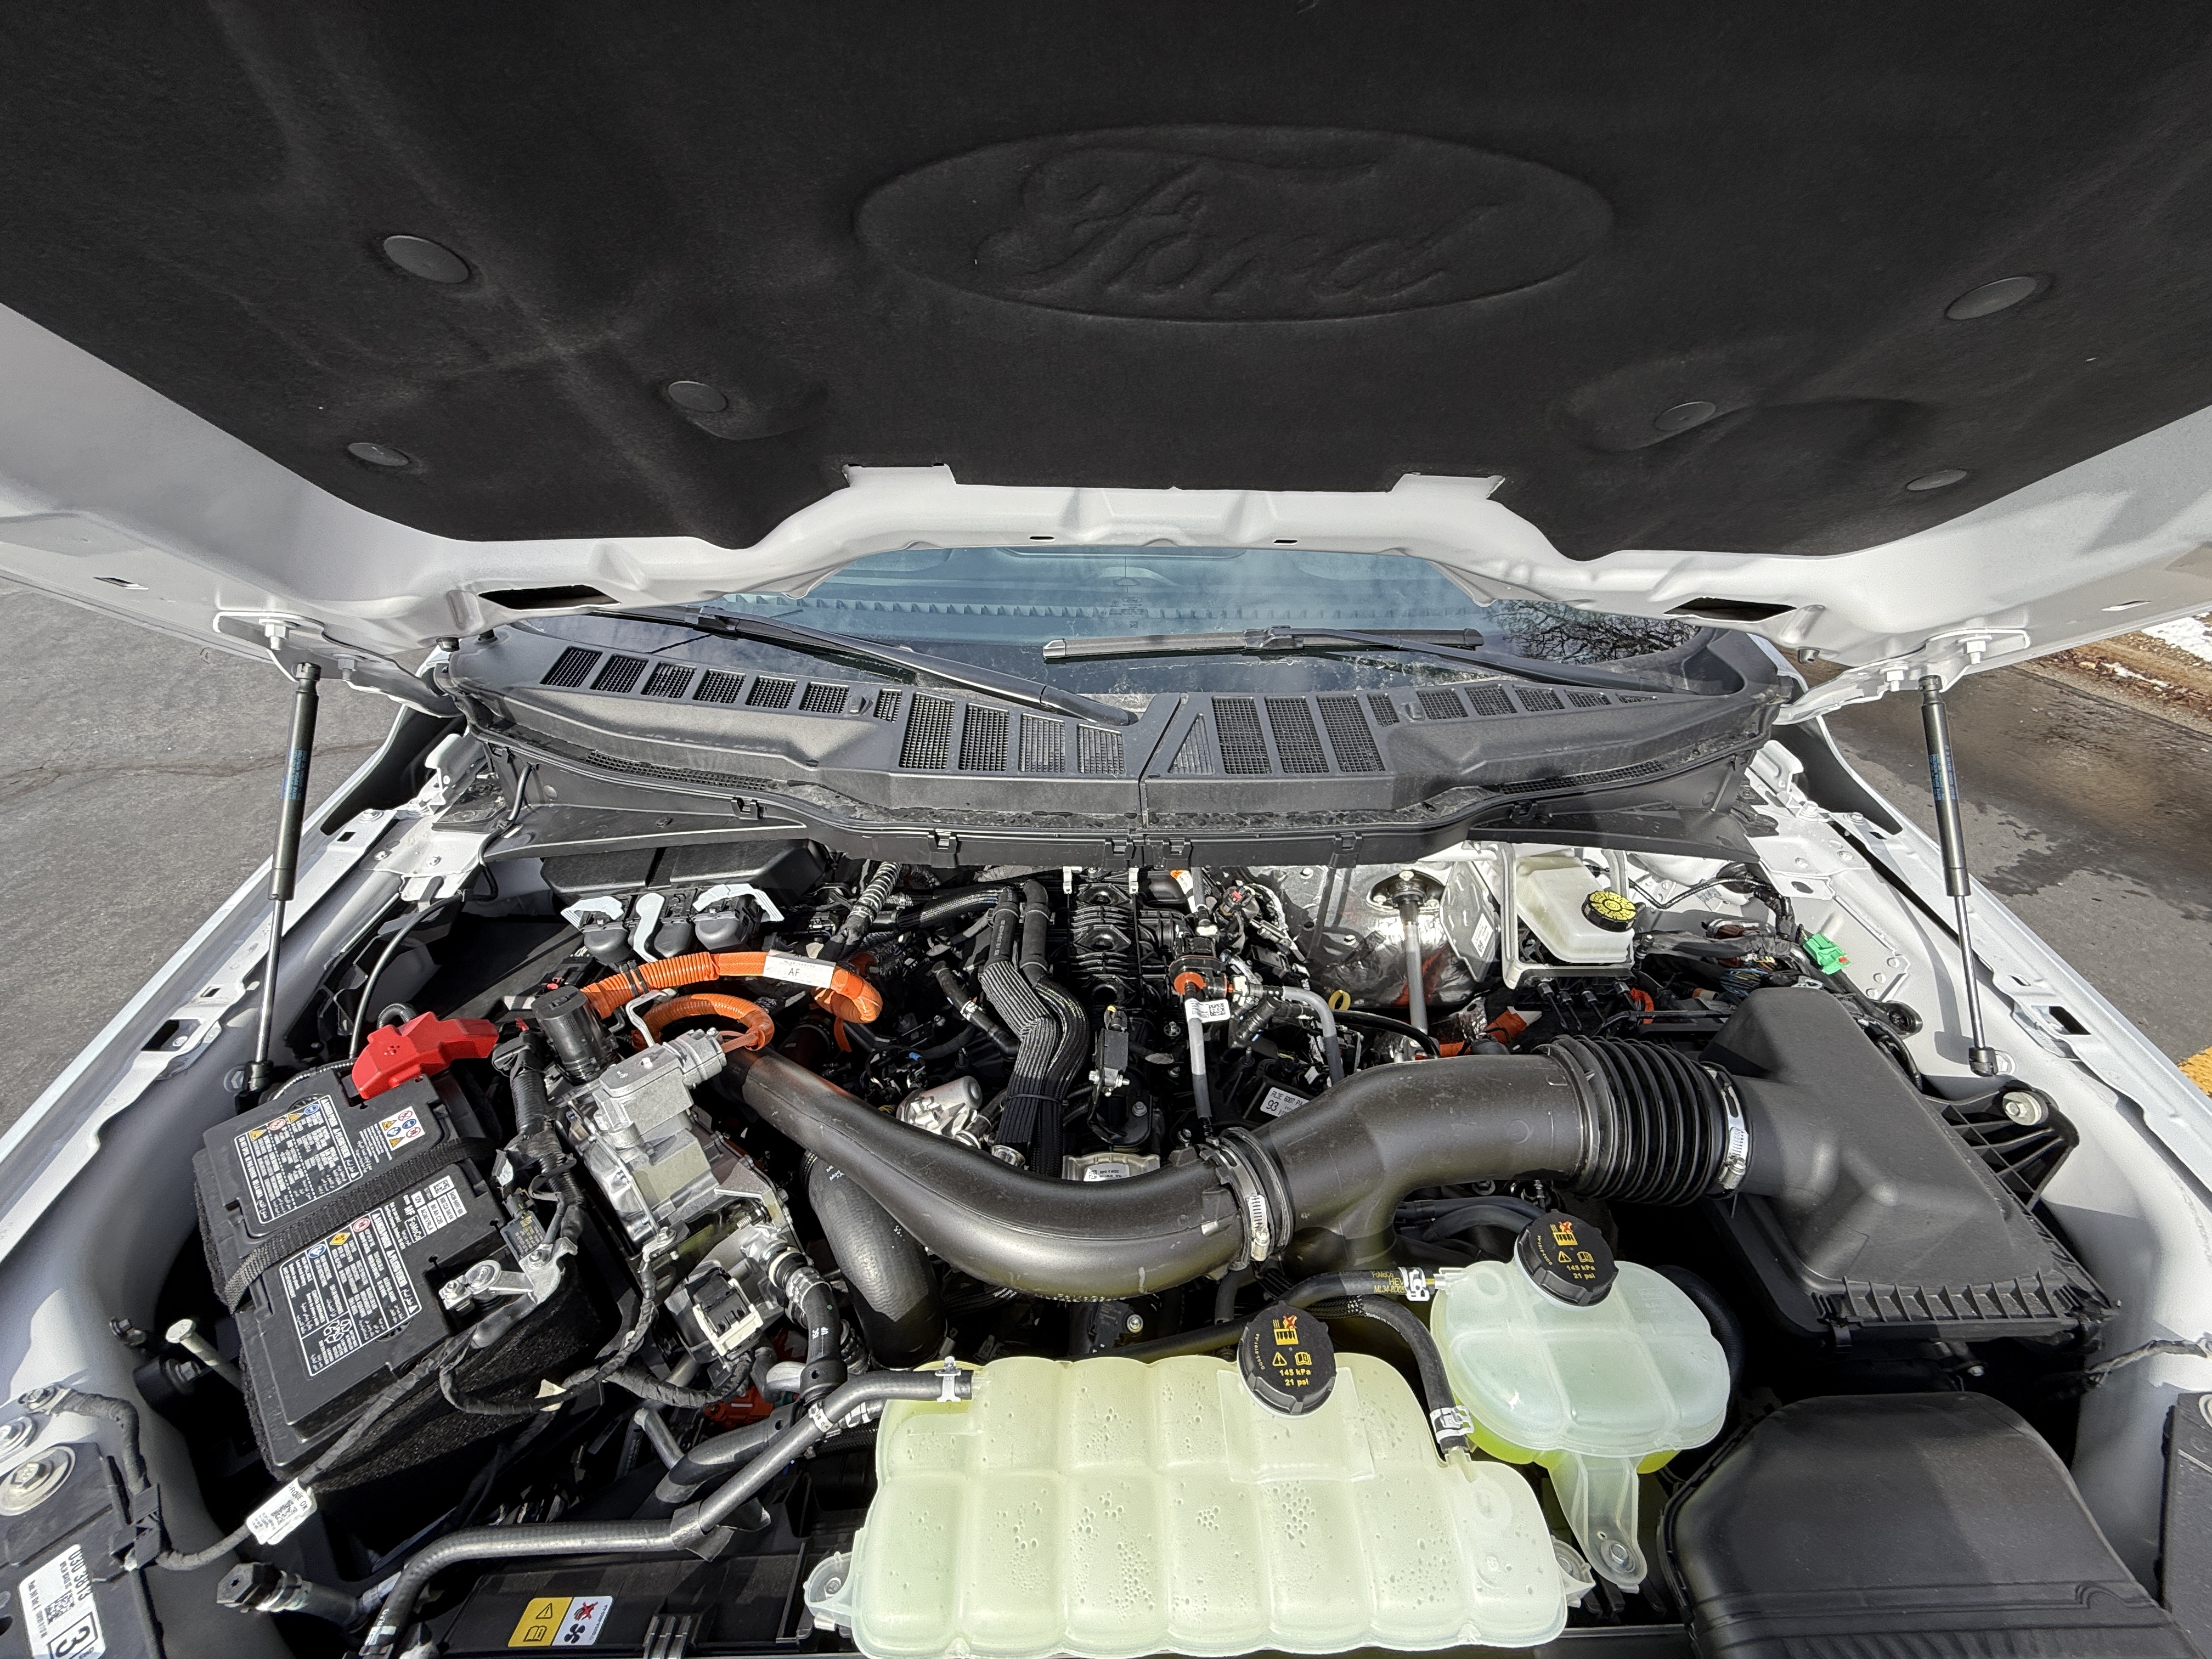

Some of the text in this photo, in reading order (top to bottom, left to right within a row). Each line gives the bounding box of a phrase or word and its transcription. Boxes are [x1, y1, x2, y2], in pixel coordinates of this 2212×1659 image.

[974, 145, 1504, 301] Ford
[788, 968, 800, 977] AF
[1266, 1099, 1279, 1111] 93
[414, 1194, 422, 1204] 12V
[403, 1204, 416, 1218] MF
[435, 1214, 444, 1224] C20
[405, 1216, 424, 1242] FoMoCo
[1374, 1285, 1407, 1293] ML34-8D05
[820, 1327, 828, 1335] UP
[1297, 1379, 1309, 1387] psi
[288, 1483, 308, 1511] ORQUE OK
[55, 1626, 90, 1657] 3
